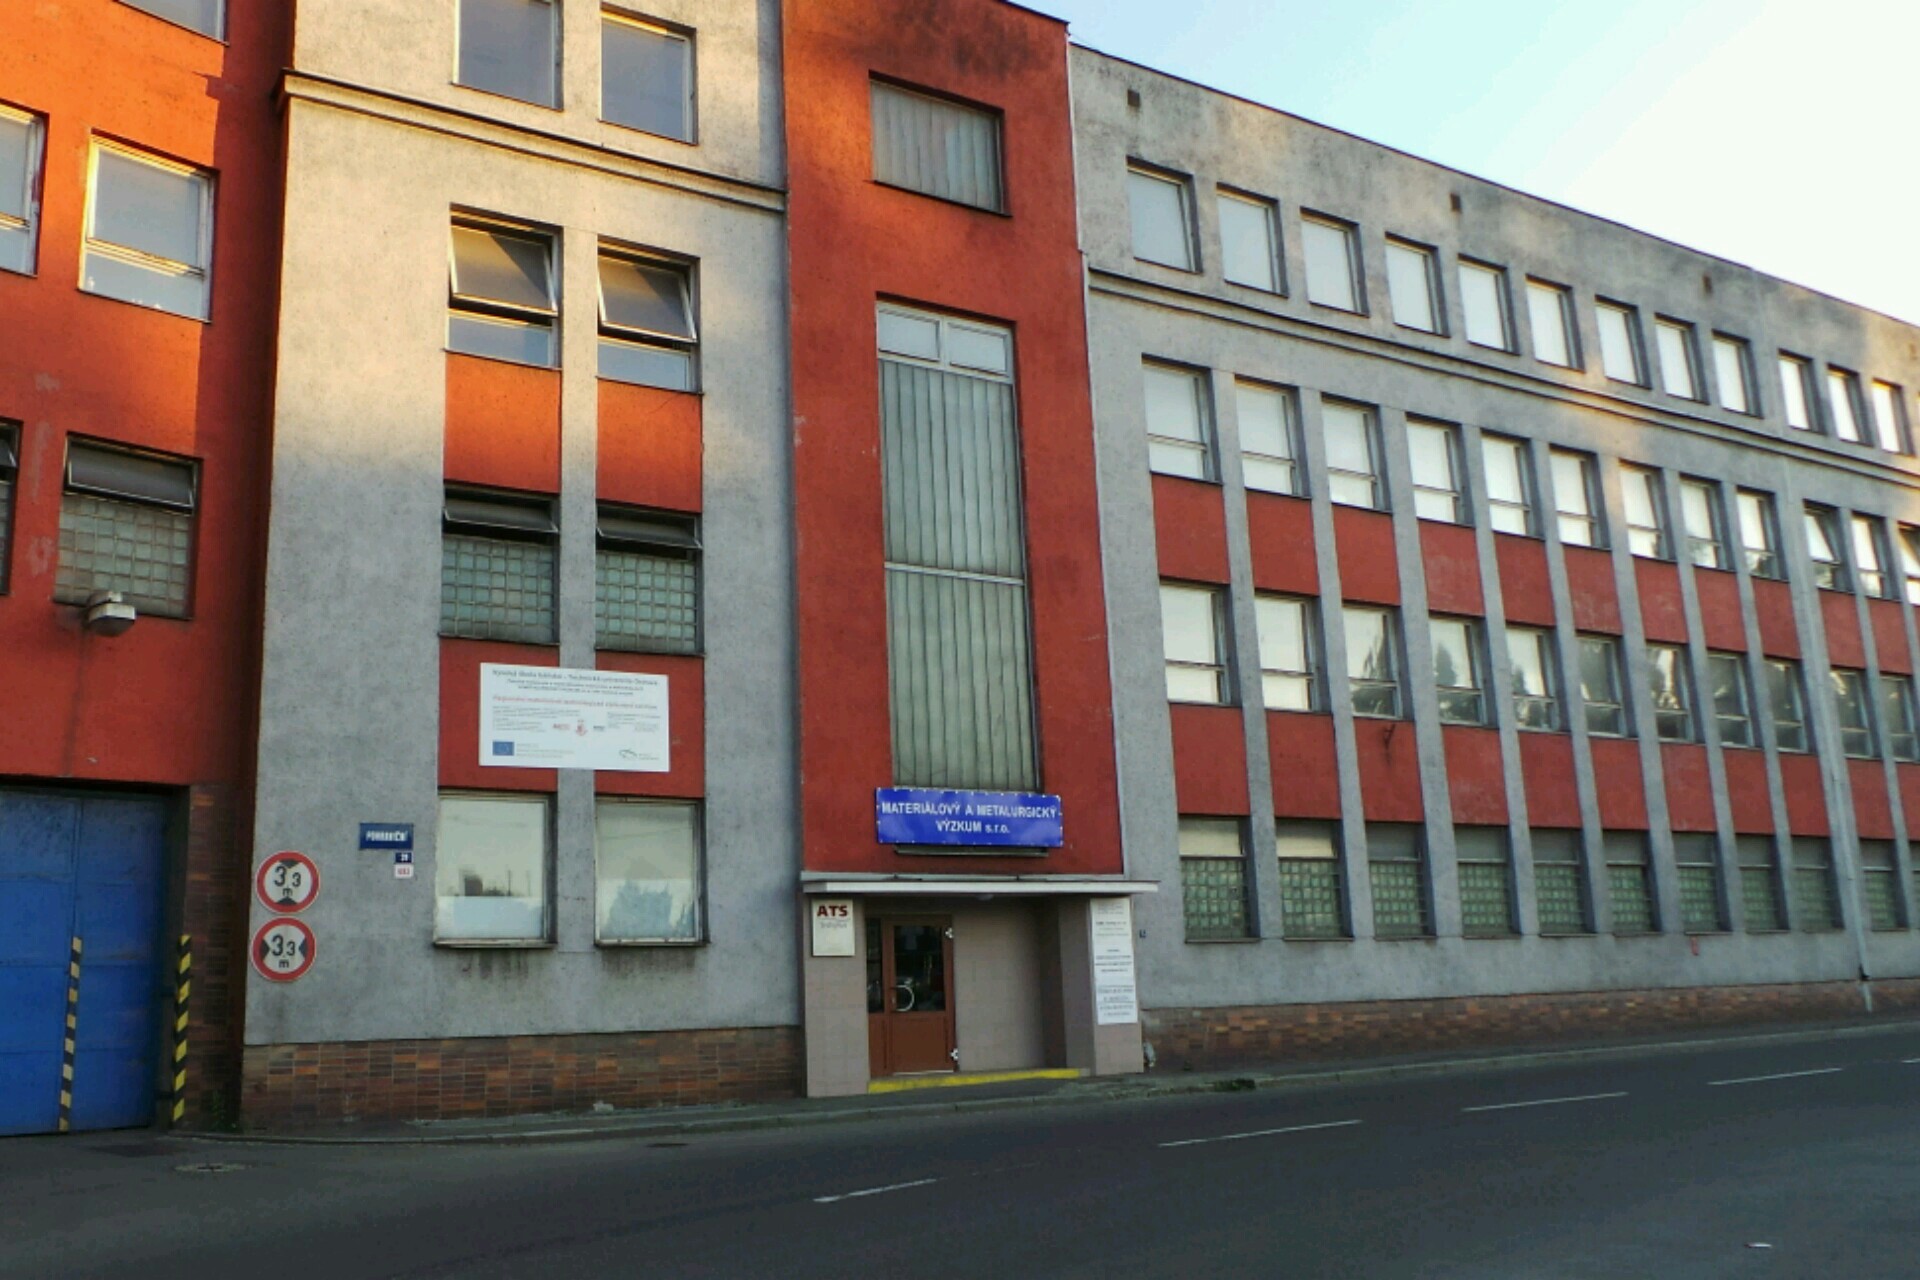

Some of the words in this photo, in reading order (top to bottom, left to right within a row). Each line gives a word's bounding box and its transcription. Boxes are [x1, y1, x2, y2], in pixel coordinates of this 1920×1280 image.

[881, 800, 961, 816] MATERIÁLOVÝ
[965, 804, 974, 815] A
[977, 803, 1058, 818] METALURGICKÝ
[935, 818, 982, 832] VÝZKUM
[985, 823, 1010, 834] s.r.o.
[816, 904, 848, 917] ATS
